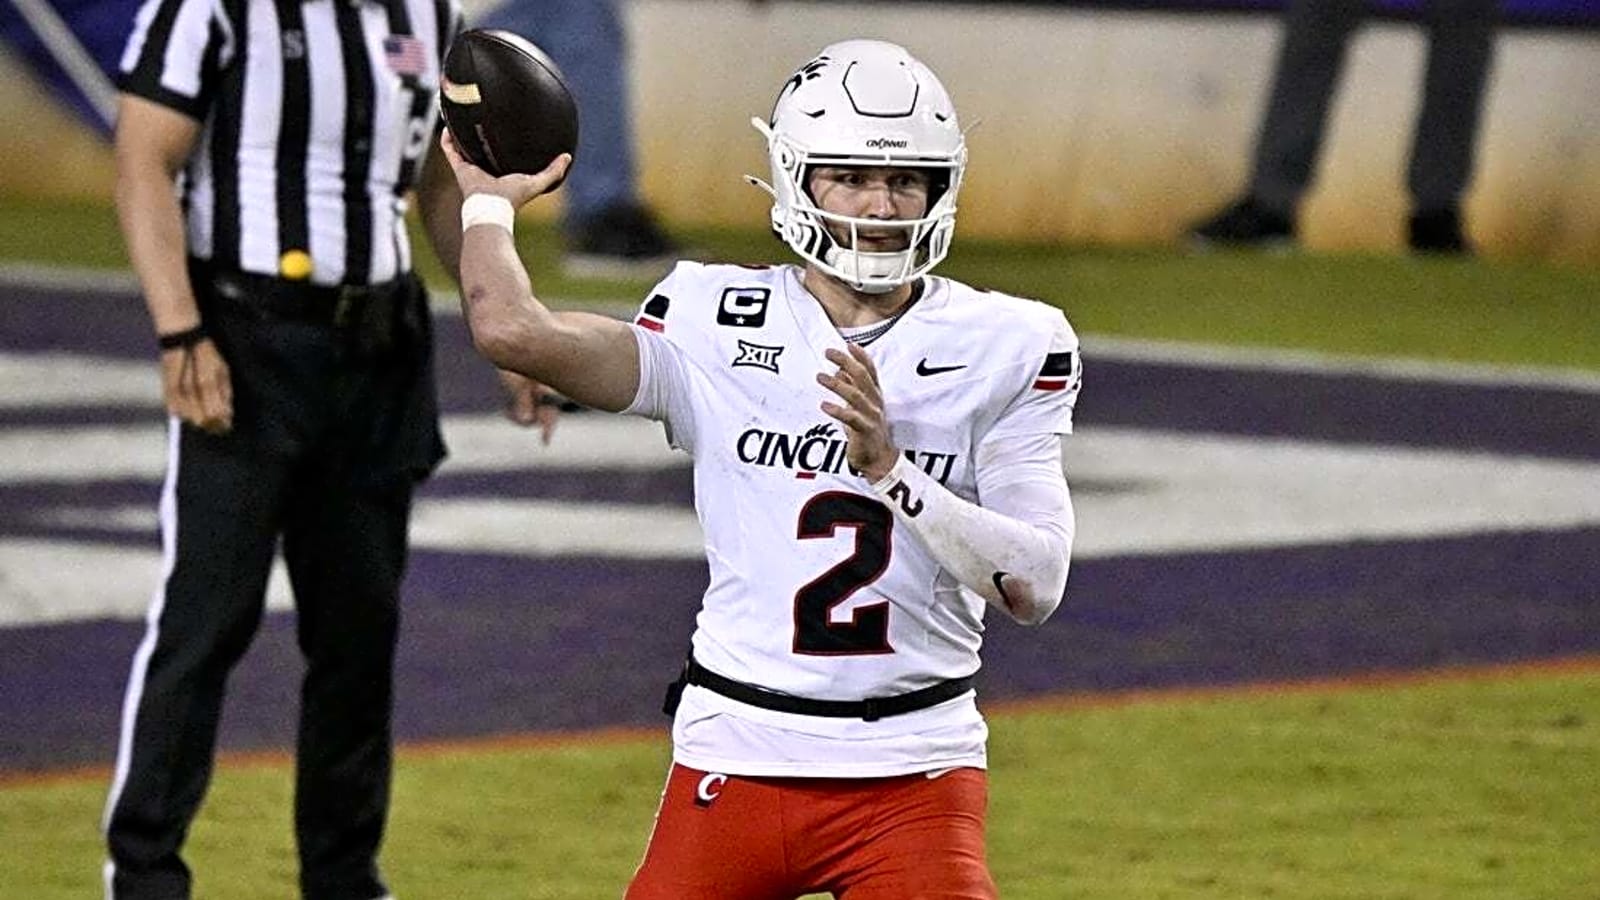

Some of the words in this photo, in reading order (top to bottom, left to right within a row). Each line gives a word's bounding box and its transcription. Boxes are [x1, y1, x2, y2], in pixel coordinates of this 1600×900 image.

[723, 290, 766, 315] C
[887, 480, 924, 518] 2
[792, 490, 897, 657] 2
[698, 772, 728, 801] C
